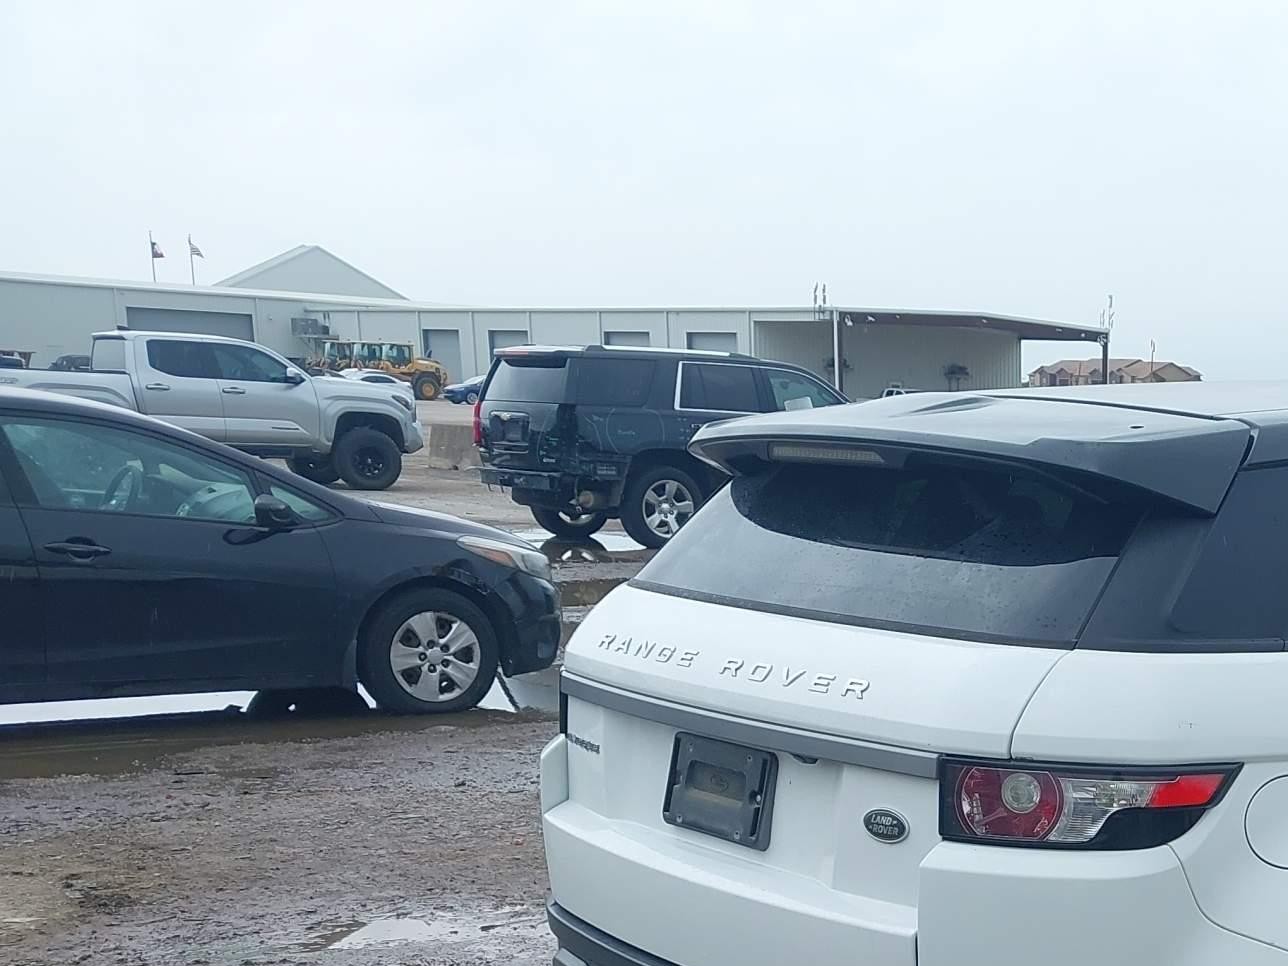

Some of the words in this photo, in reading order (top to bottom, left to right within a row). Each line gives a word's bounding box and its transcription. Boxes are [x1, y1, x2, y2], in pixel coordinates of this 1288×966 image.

[597, 633, 700, 669] RANGE
[719, 656, 872, 701] ROVER
[871, 814, 892, 825] LAND
[872, 824, 899, 836] ROVER
